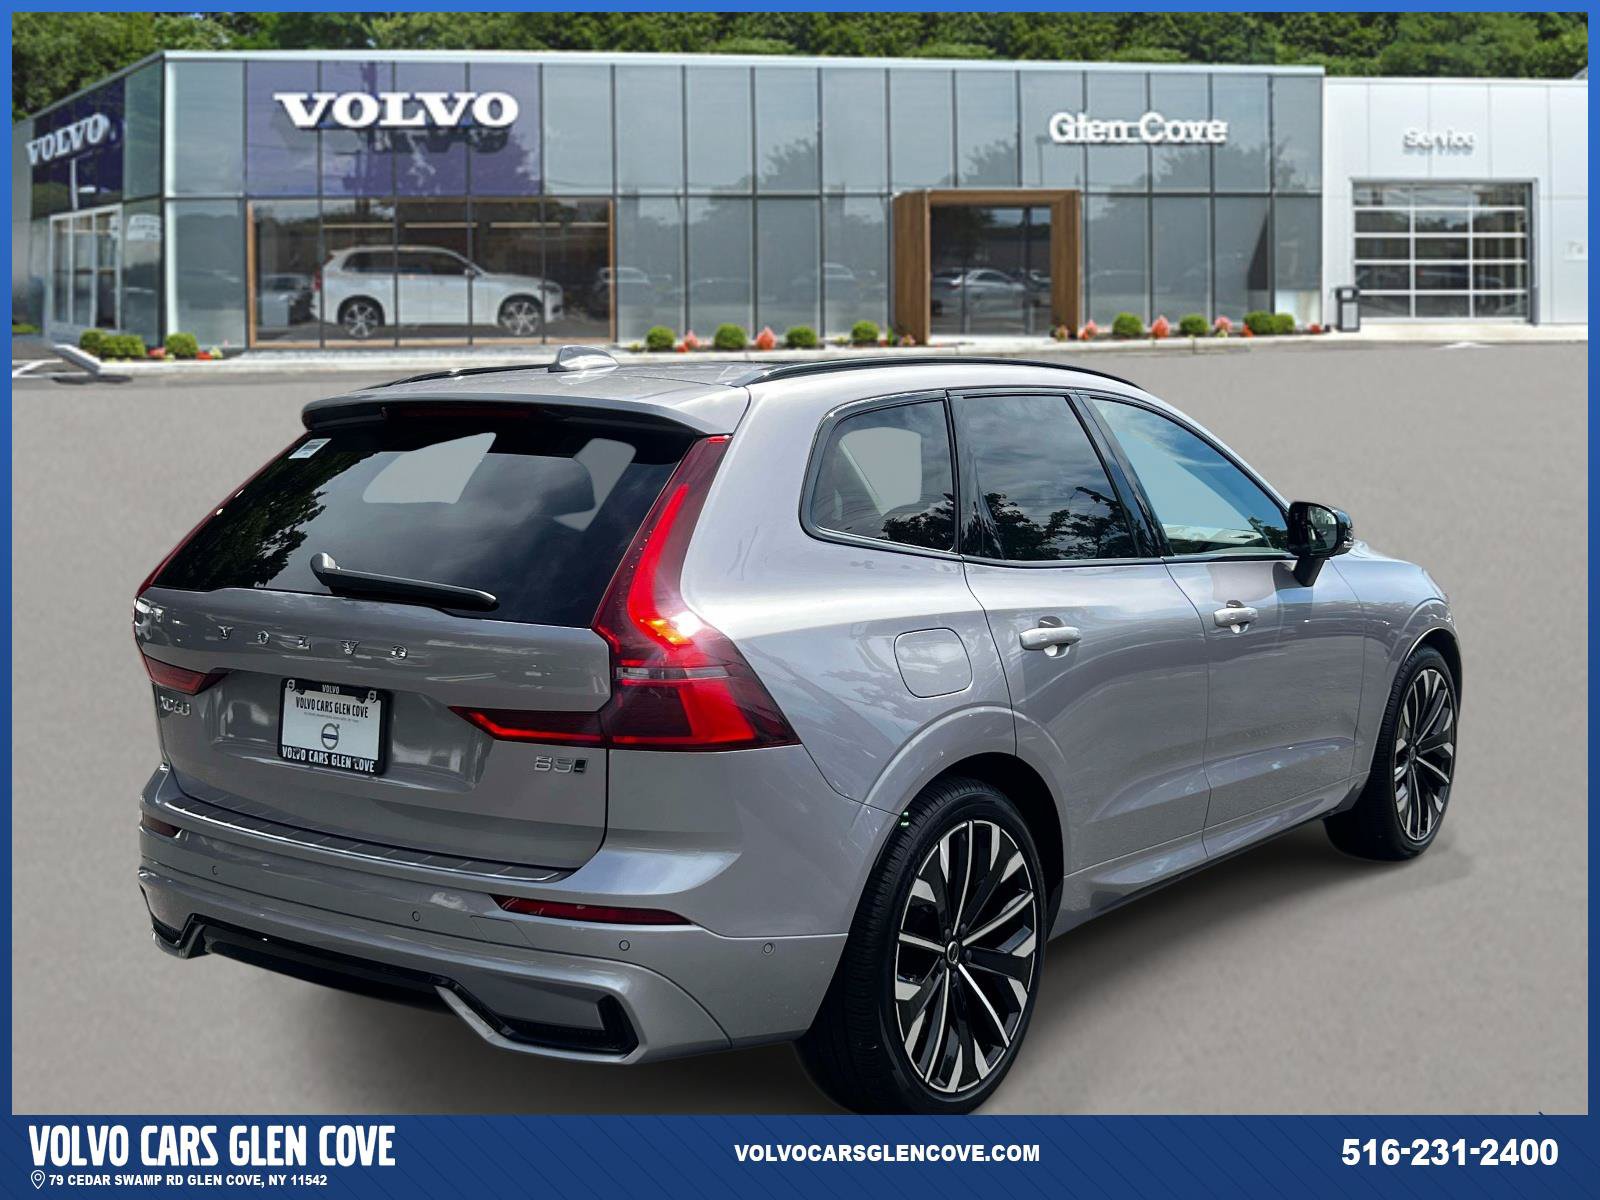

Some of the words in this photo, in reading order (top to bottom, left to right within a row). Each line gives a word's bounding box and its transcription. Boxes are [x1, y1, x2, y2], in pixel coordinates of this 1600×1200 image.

[274, 92, 519, 127] VOLVO
[26, 113, 110, 165] VOLVO
[1050, 112, 1126, 143] Glen
[1139, 112, 1228, 143] Cove
[1402, 127, 1475, 155] Service
[218, 625, 408, 660] VOLVO
[322, 685, 340, 694] VOLVO
[295, 696, 315, 711] VOLVO
[316, 700, 333, 713] CARS
[334, 703, 351, 716] GLEN
[352, 705, 369, 719] COVE
[282, 746, 306, 761] VOLVO
[308, 750, 329, 765] CARS
[331, 754, 352, 769] GLEN
[353, 758, 375, 773] COVE
